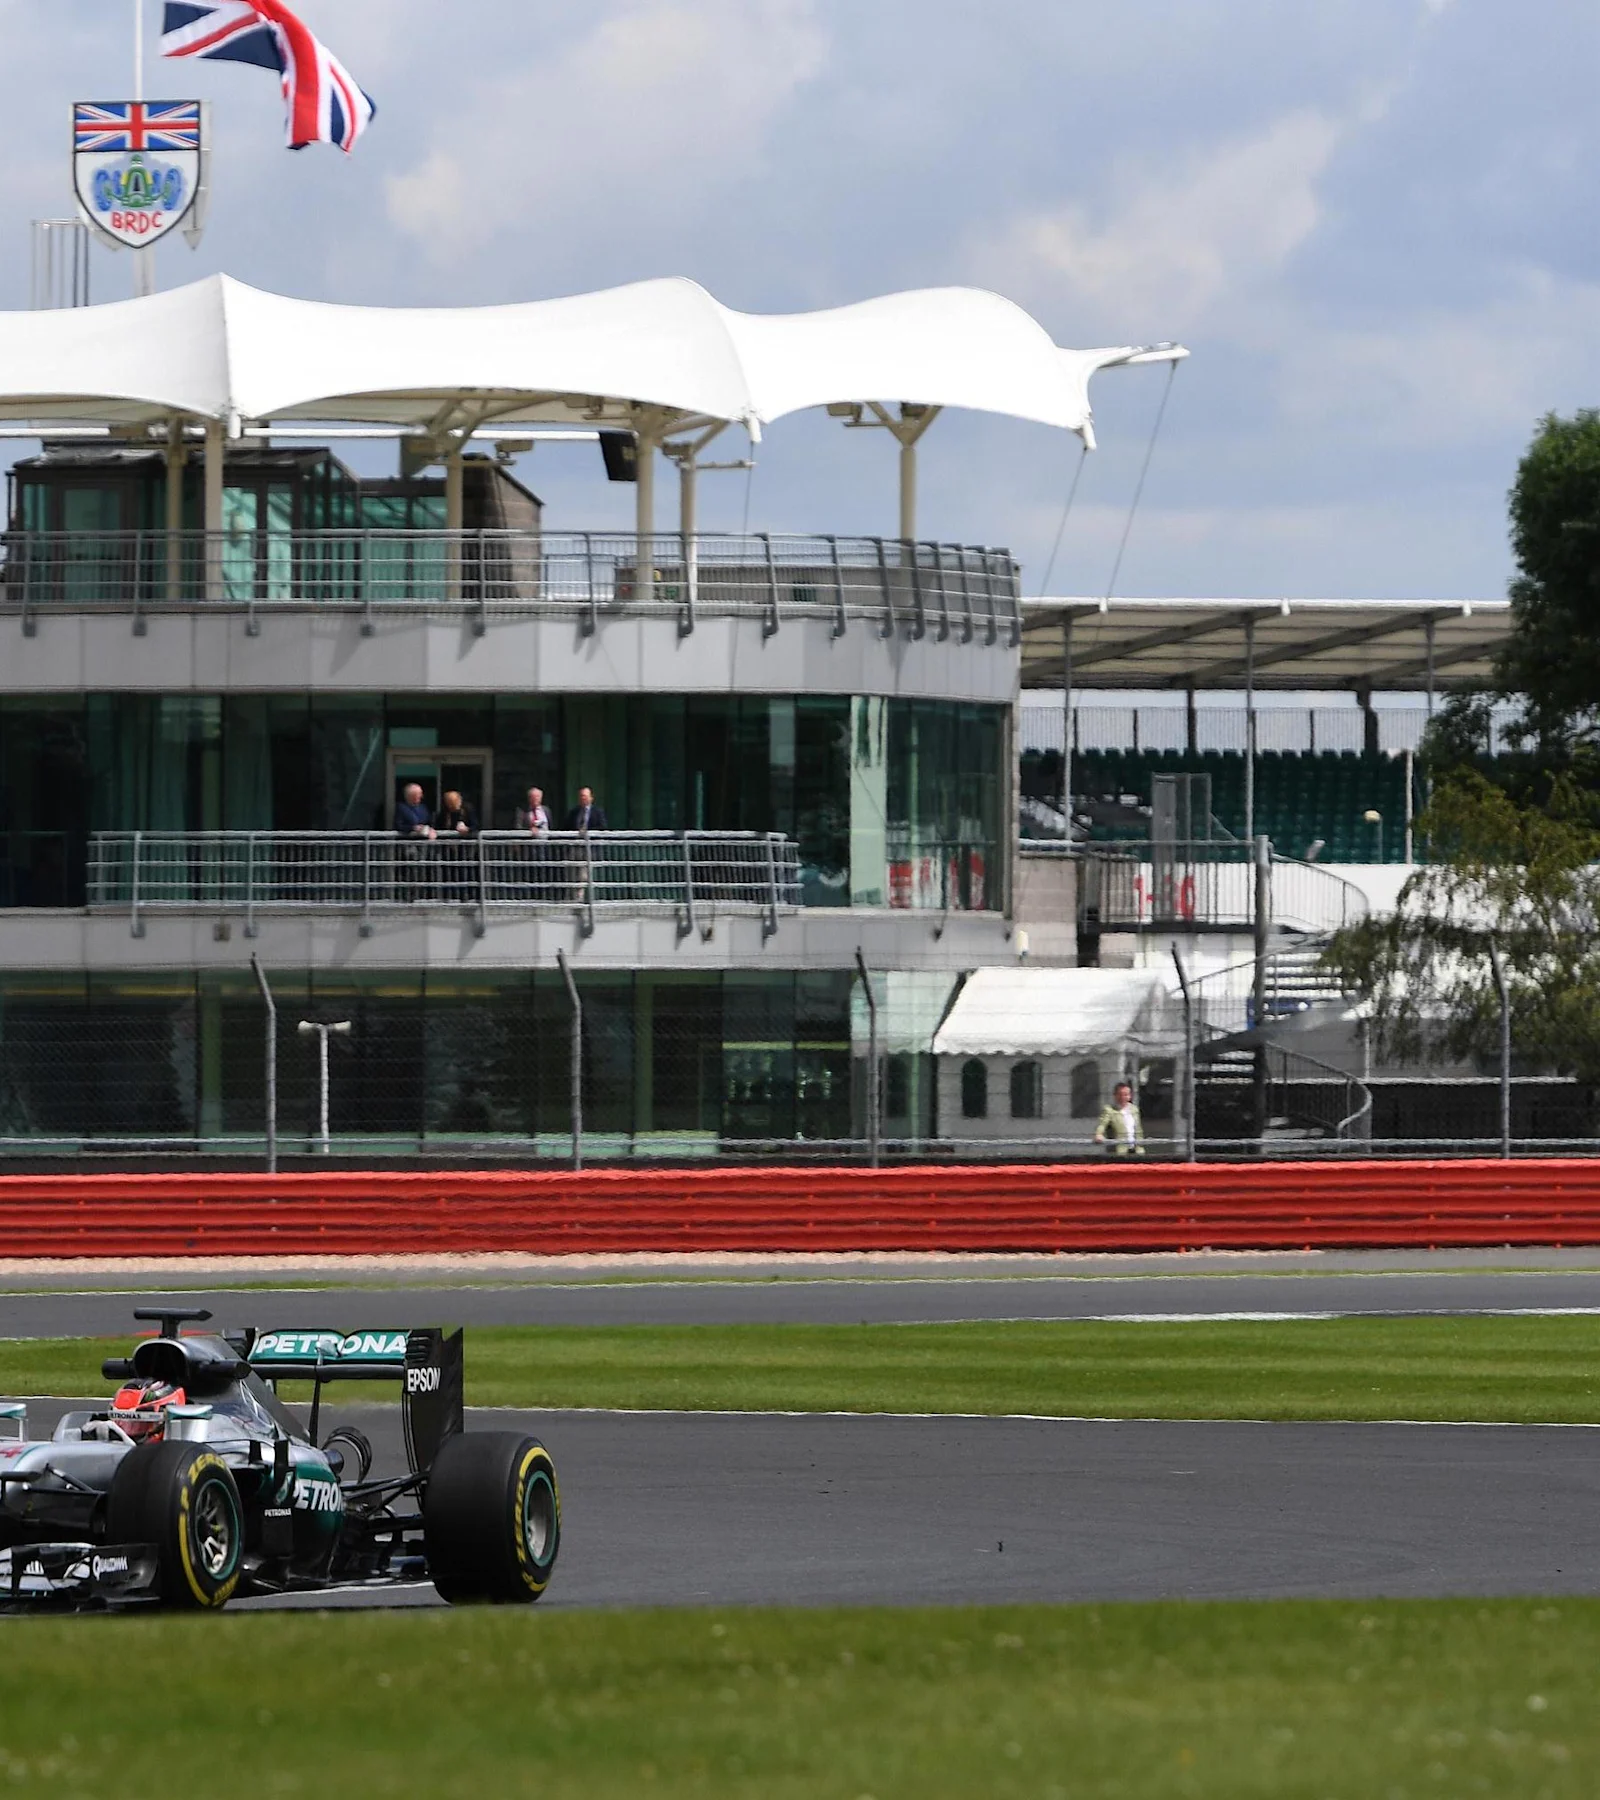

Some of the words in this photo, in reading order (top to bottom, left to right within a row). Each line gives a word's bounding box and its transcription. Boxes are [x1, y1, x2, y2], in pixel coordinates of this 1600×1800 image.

[111, 212, 163, 233] BRDC
[407, 1367, 441, 1392] EPSON
[264, 1508, 292, 1517] PETRONAS
[92, 1554, 128, 1581] QUALCOMM
